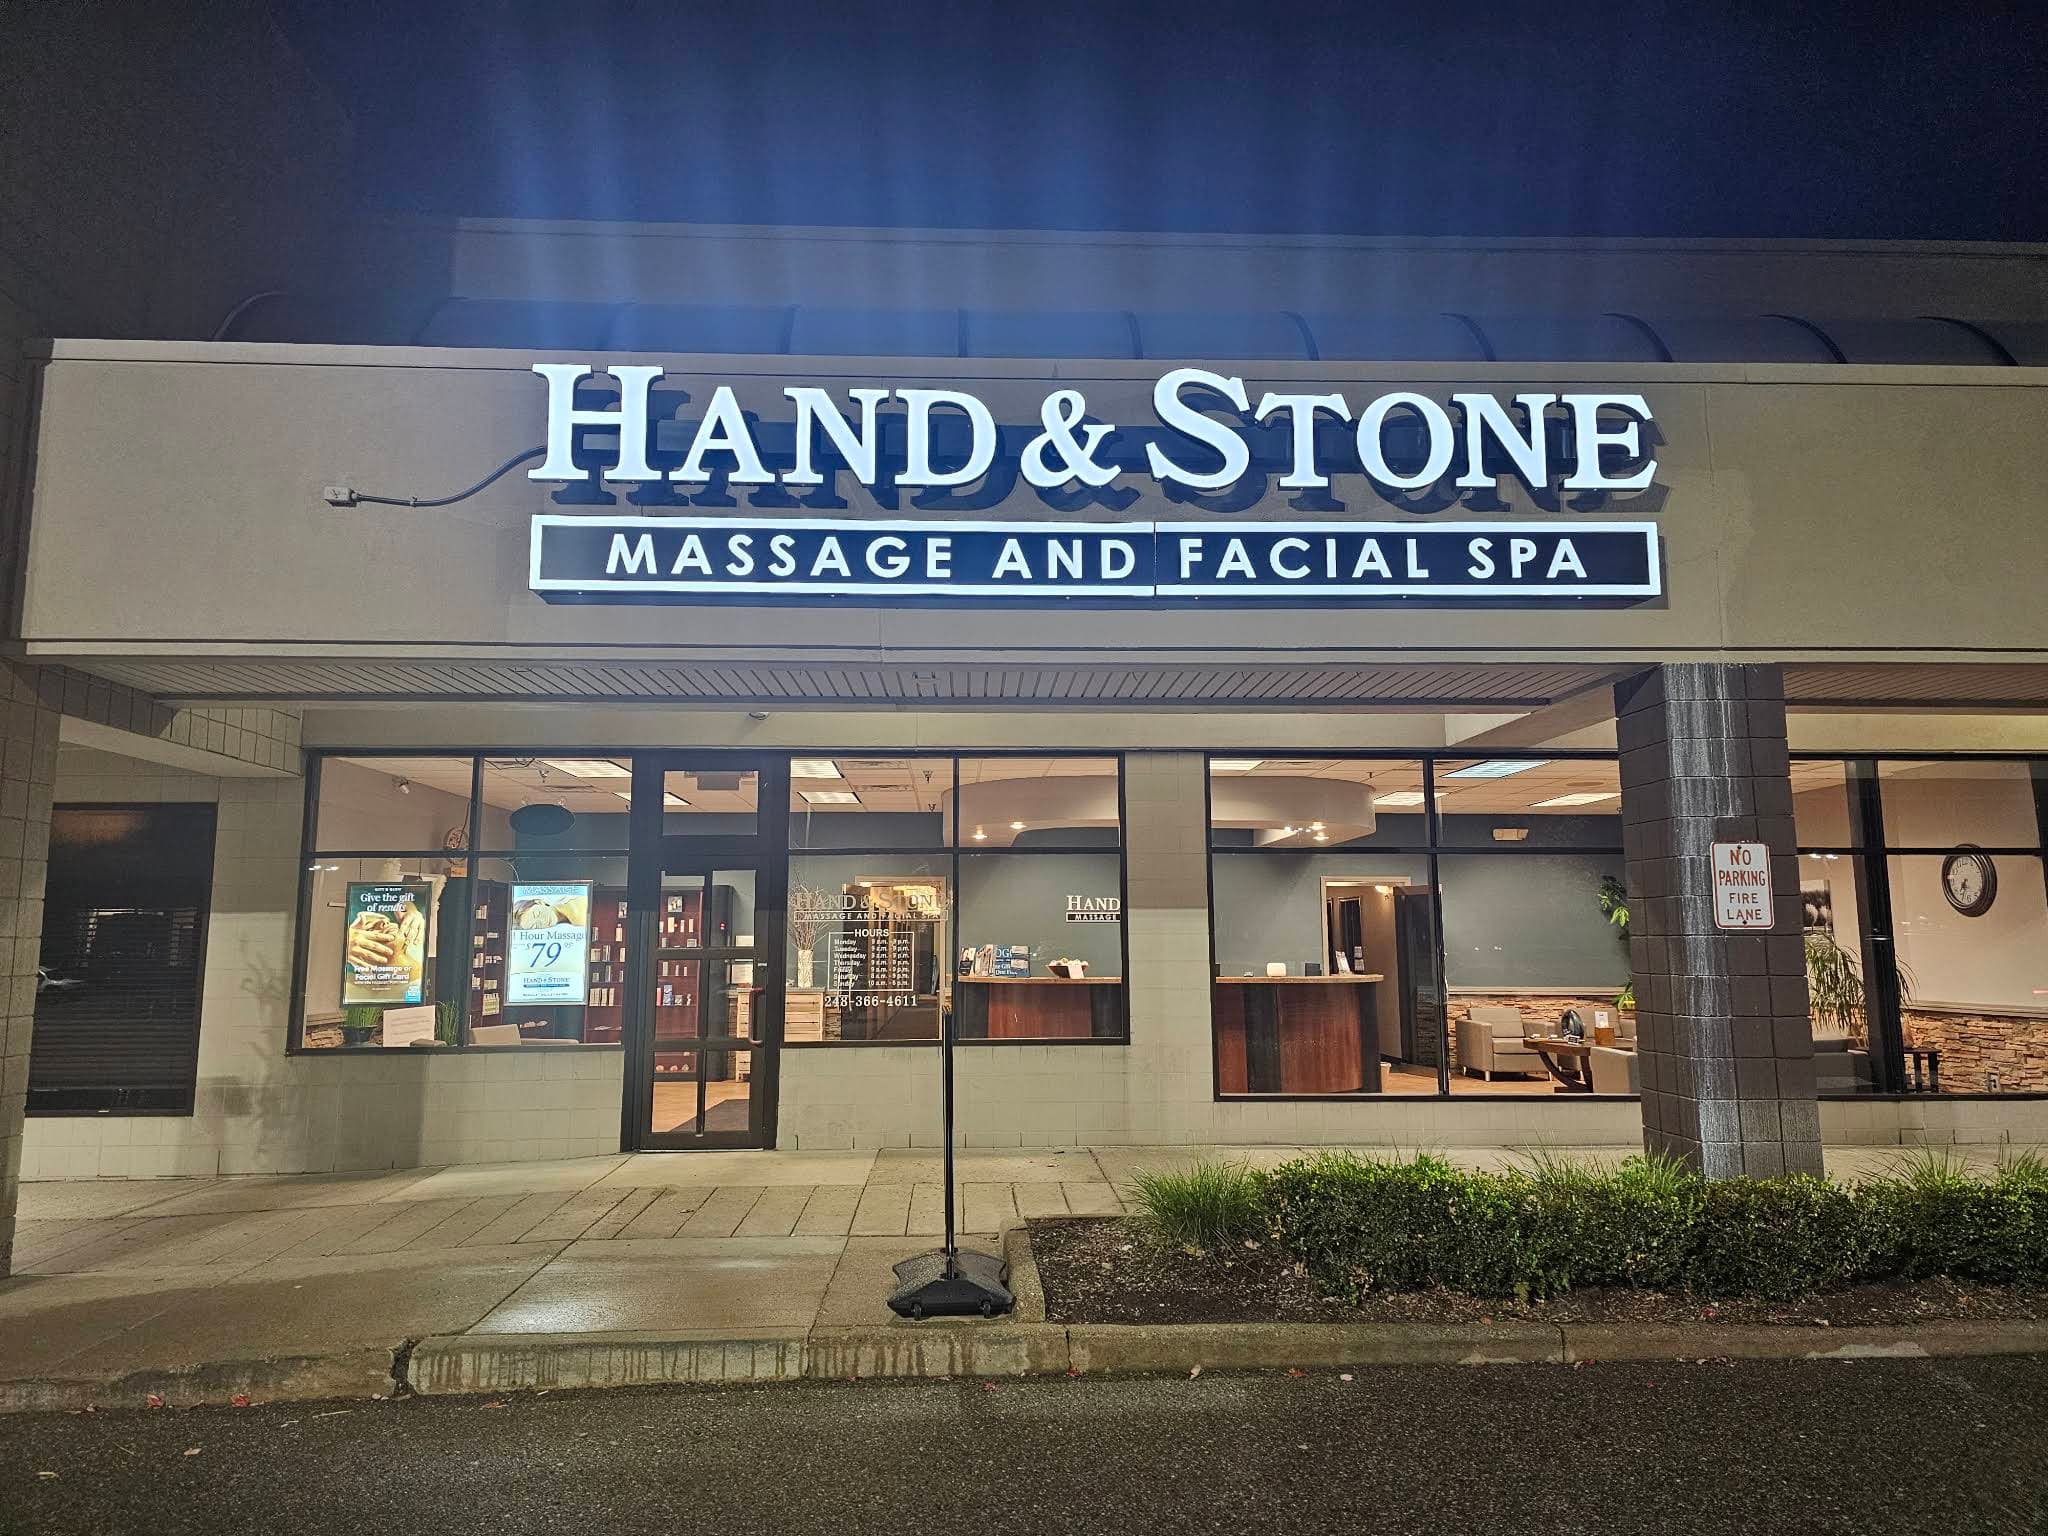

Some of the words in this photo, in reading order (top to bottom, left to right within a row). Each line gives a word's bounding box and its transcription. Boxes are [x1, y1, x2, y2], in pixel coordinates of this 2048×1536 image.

[528, 363, 997, 486] HAND
[1021, 389, 1121, 487] &
[1145, 367, 1658, 489] STONE
[605, 533, 952, 578] MASSAGE
[992, 538, 1135, 579] AND
[1180, 538, 1430, 579] FACIAL
[1467, 538, 1588, 579] SPA
[1730, 849, 1751, 865] NO
[1719, 870, 1766, 887] PARKING
[360, 893, 381, 902] Give
[382, 893, 398, 902] the
[399, 892, 415, 904] gift
[1066, 895, 1120, 911] HAND
[1729, 893, 1758, 904] FIRE
[367, 903, 378, 912] of
[1727, 909, 1762, 920] LANE
[520, 931, 545, 941] Hour
[854, 928, 890, 938] HOURS
[824, 995, 917, 1007] 248-366-4611
